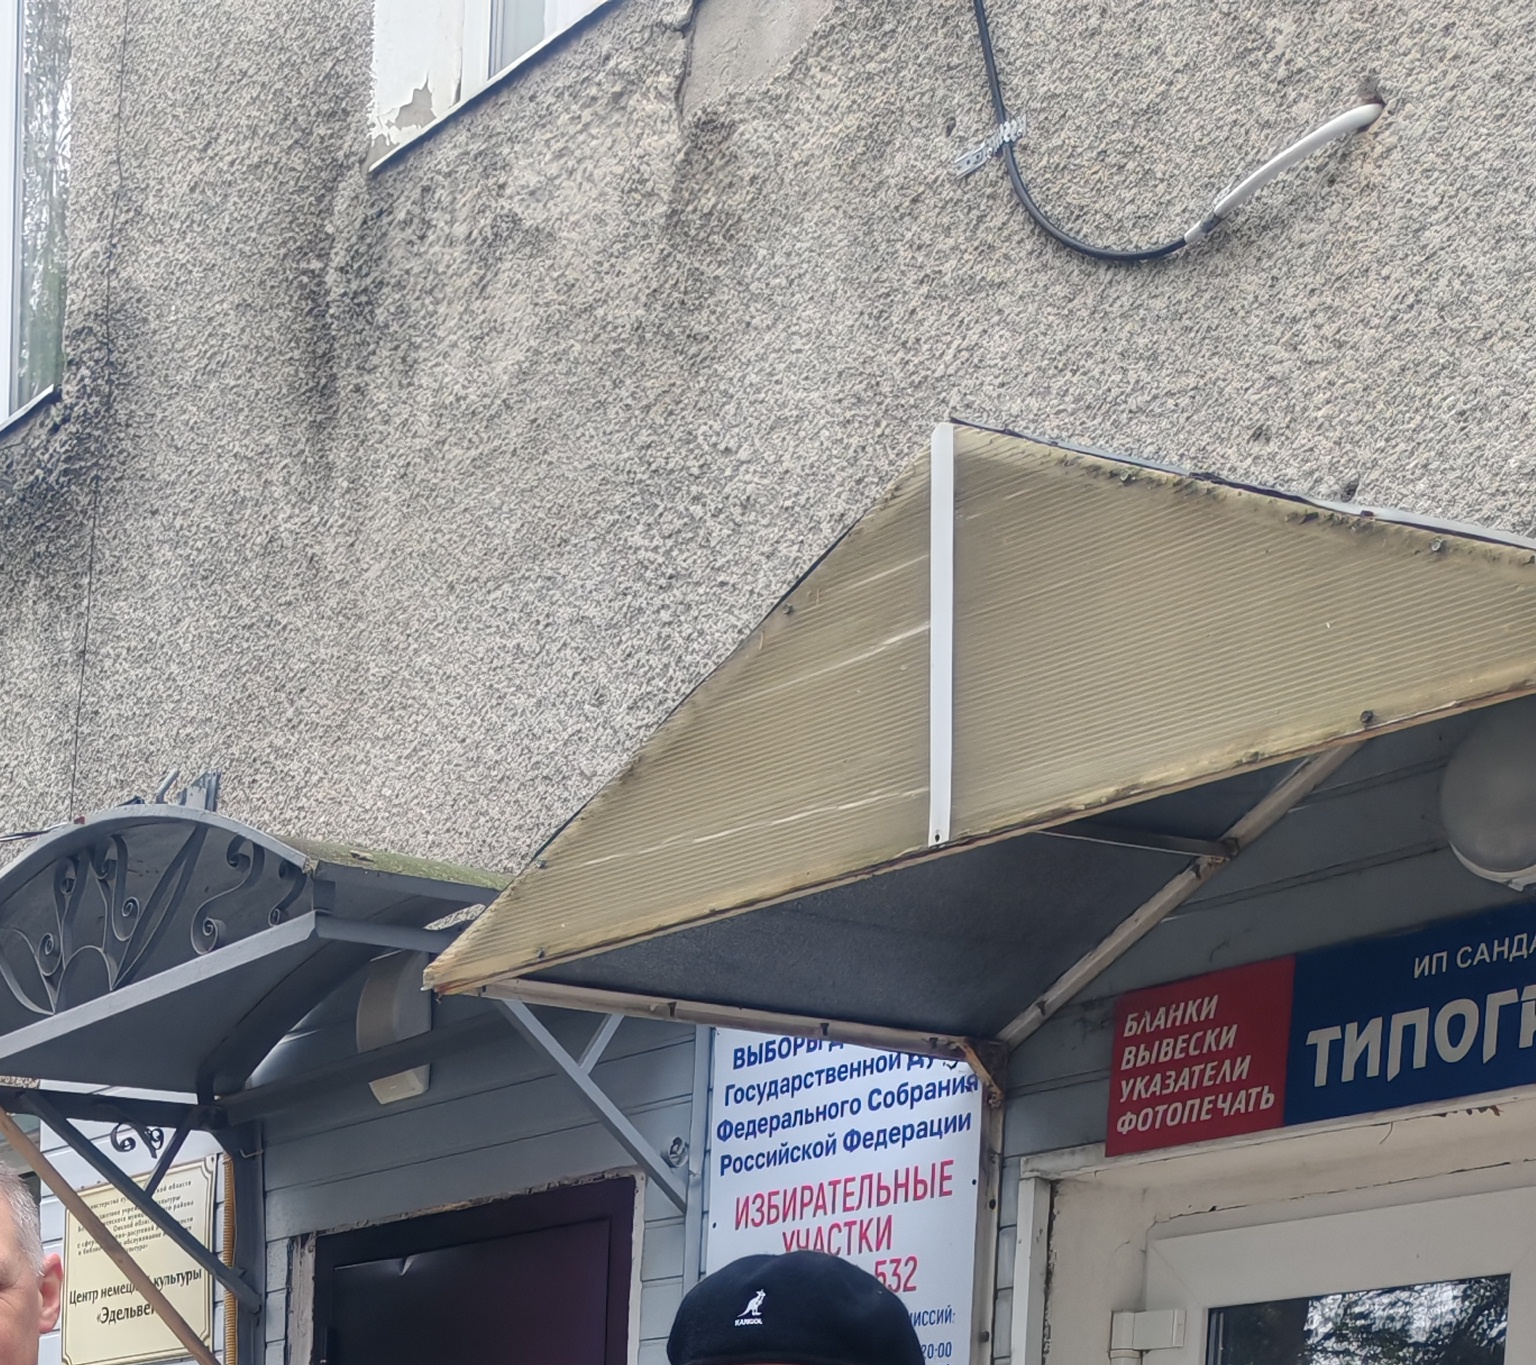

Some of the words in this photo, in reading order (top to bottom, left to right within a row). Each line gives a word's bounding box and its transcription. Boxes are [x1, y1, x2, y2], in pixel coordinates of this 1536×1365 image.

[1413, 951, 1448, 979] ИП
[1123, 994, 1219, 1038] БЛАНКИ
[1120, 1024, 1238, 1071] ВЫВЕСКИ
[724, 1051, 901, 1106] Государственной
[1119, 1056, 1252, 1104] УКАЗАТЕЛИ
[716, 1097, 862, 1142] Федерального
[867, 1072, 979, 1112] Собрания
[1116, 1086, 1276, 1135] ФОТОПЕЧАТЬ
[720, 1132, 837, 1177] Российской
[842, 1112, 972, 1153] Федерации
[734, 1159, 954, 1231] ИЗБИРАТЕЛЬНЫЕ
[782, 1214, 893, 1256] УЧАСТКИ
[69, 1289, 99, 1306] Центр
[154, 1268, 202, 1291] культуры
[874, 1255, 918, 1293] 532
[96, 1302, 155, 1325] «Эдельве
[911, 1304, 956, 1327] ИССИЙ:
